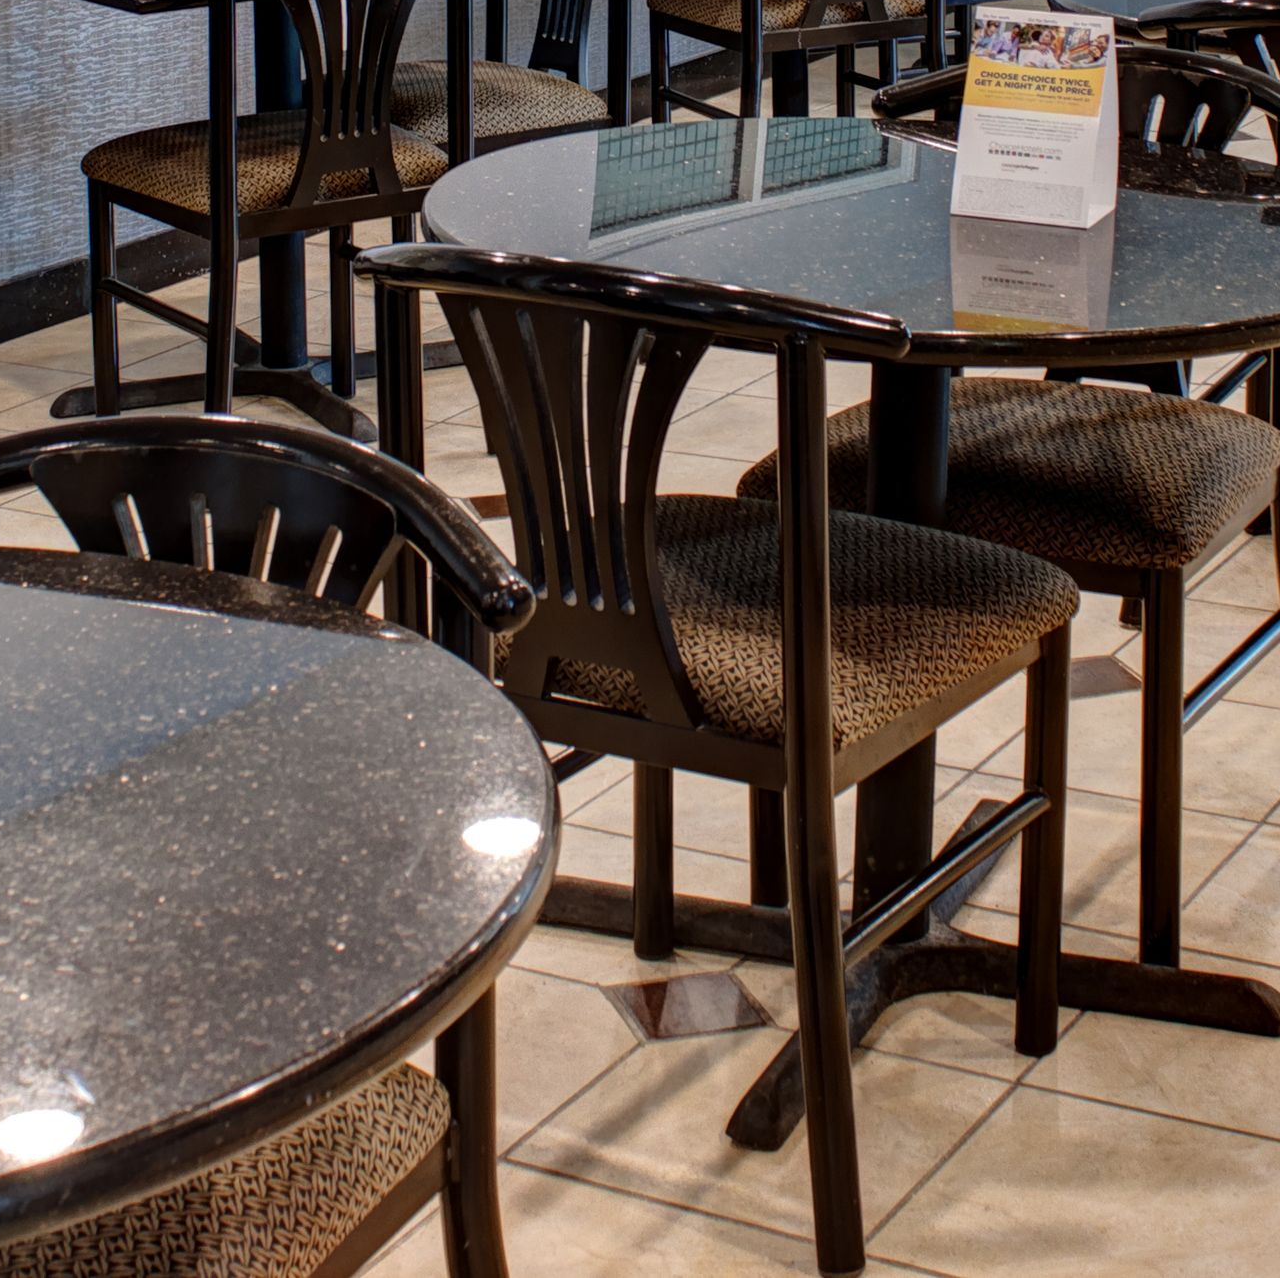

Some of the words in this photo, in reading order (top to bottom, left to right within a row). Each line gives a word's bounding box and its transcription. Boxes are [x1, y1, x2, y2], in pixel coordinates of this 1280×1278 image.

[980, 70, 1019, 81] CHOOSE
[1021, 74, 1056, 85] CHOICE
[974, 78, 993, 86] GET
[994, 79, 1004, 87] A
[1004, 81, 1033, 91] NIGHT
[1034, 83, 1047, 92] AT
[1049, 84, 1064, 94] NO
[1065, 86, 1094, 97] PRICE.
